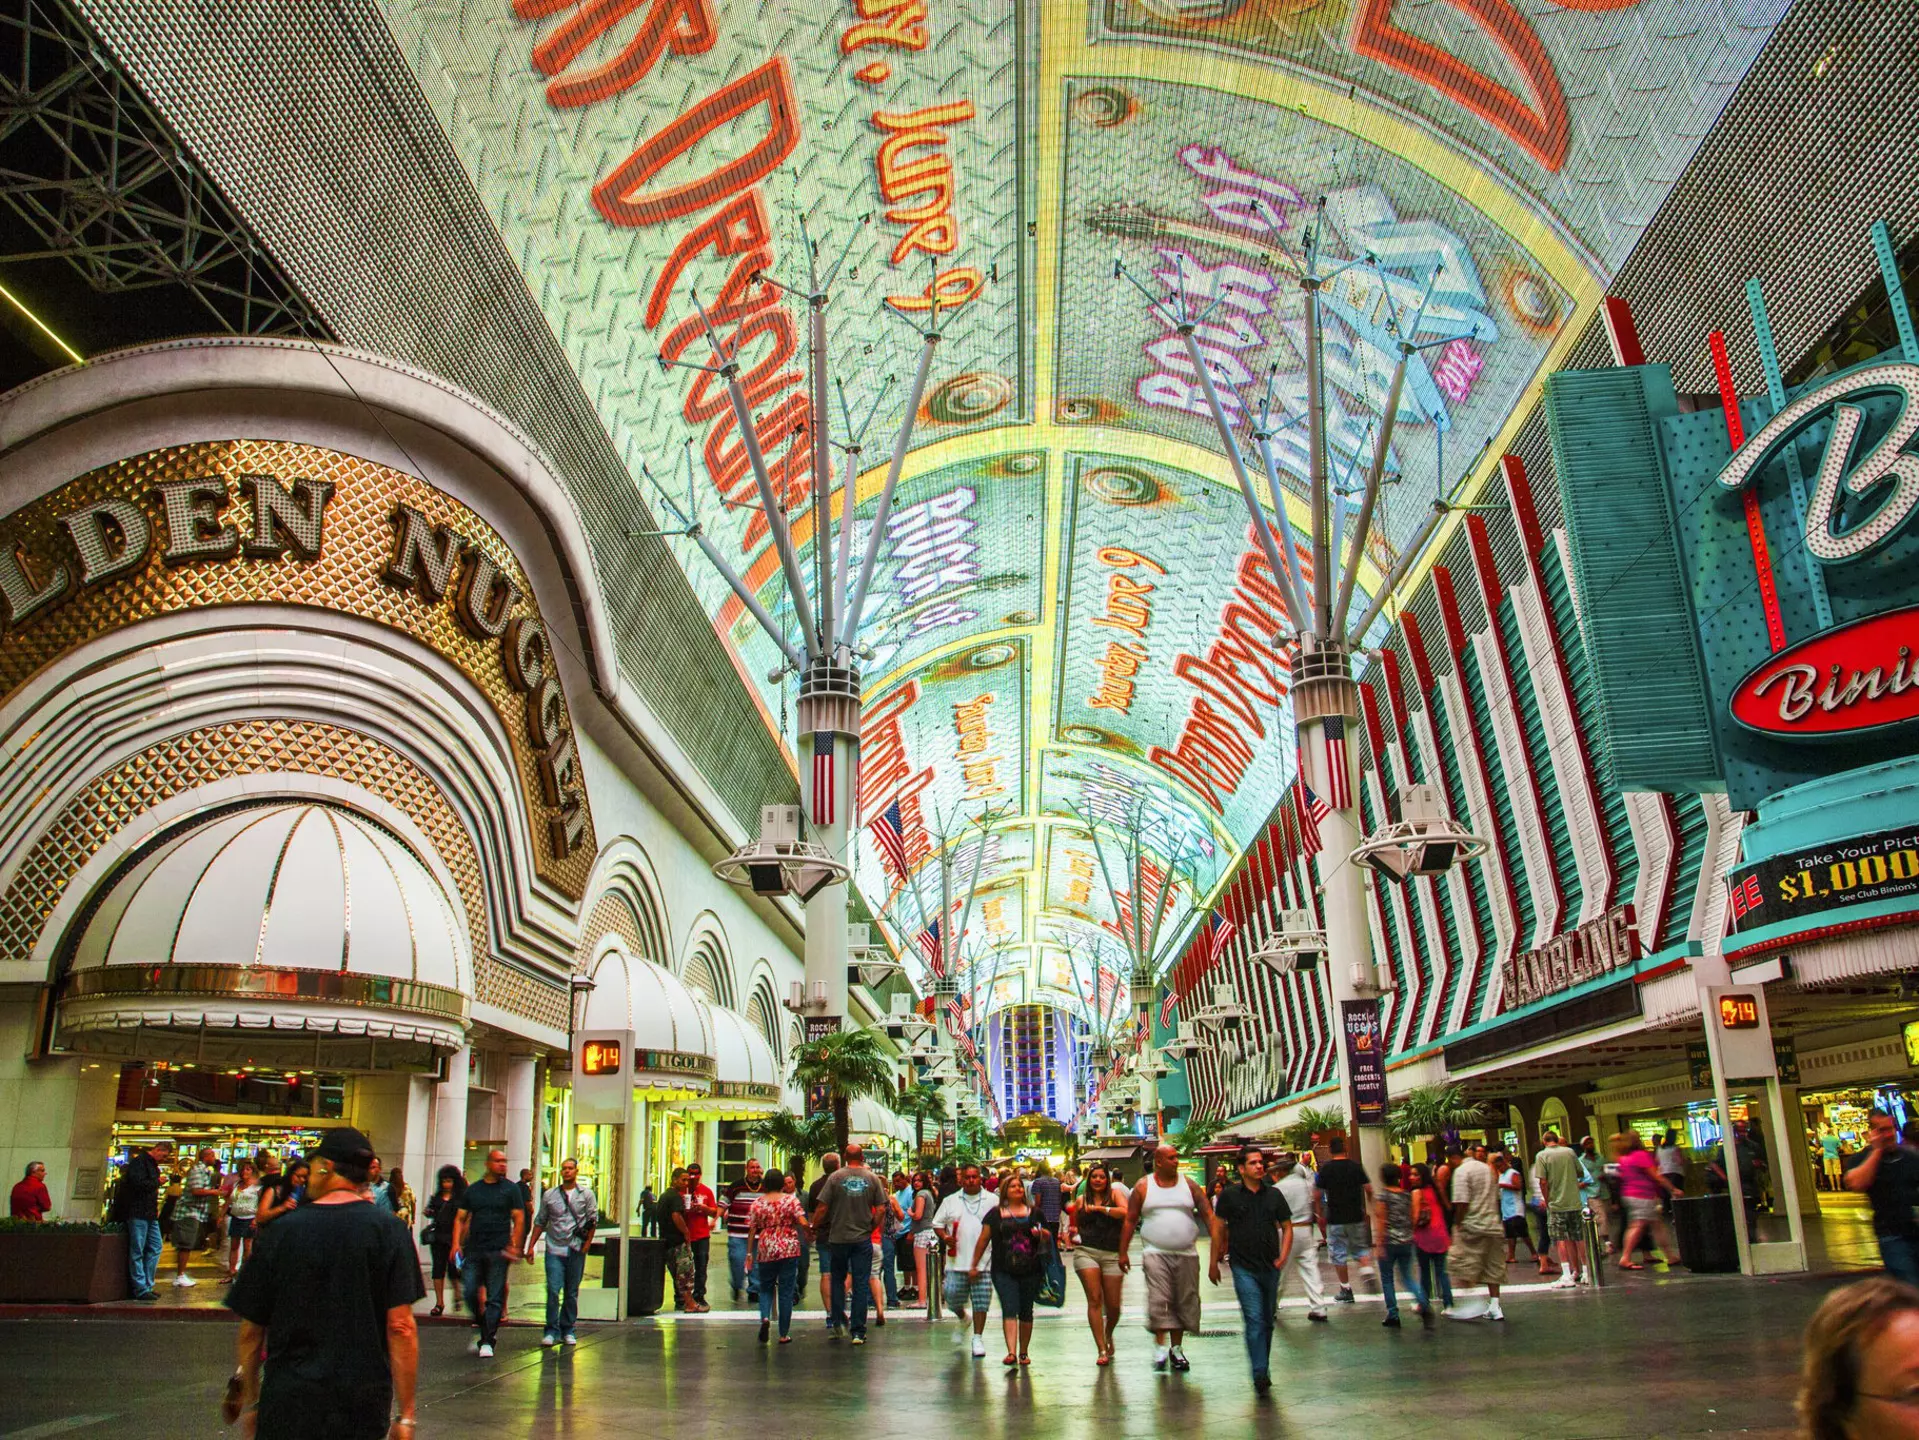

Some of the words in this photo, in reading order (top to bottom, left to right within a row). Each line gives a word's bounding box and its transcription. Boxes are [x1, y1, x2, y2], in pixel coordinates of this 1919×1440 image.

[871, 101, 975, 265] June
[1433, 339, 1484, 403] 2012
[886, 485, 980, 604] ROCK
[1098, 547, 1166, 574] 9
[907, 601, 980, 638] of
[1090, 574, 1154, 638] June
[382, 502, 588, 859] NUGGET
[1088, 641, 1149, 714] Saturday,
[1796, 853, 1833, 870] Take
[1838, 843, 1879, 860] Your
[1839, 893, 1856, 903] See
[1857, 888, 1879, 899] Club
[1880, 881, 1918, 895] Binion's
[1501, 904, 1634, 1010] GAMBLING
[809, 1023, 828, 1032] ROCK
[1347, 1012, 1366, 1022] ROCK
[1738, 1002, 1755, 1021] 14
[602, 1047, 619, 1067] 14
